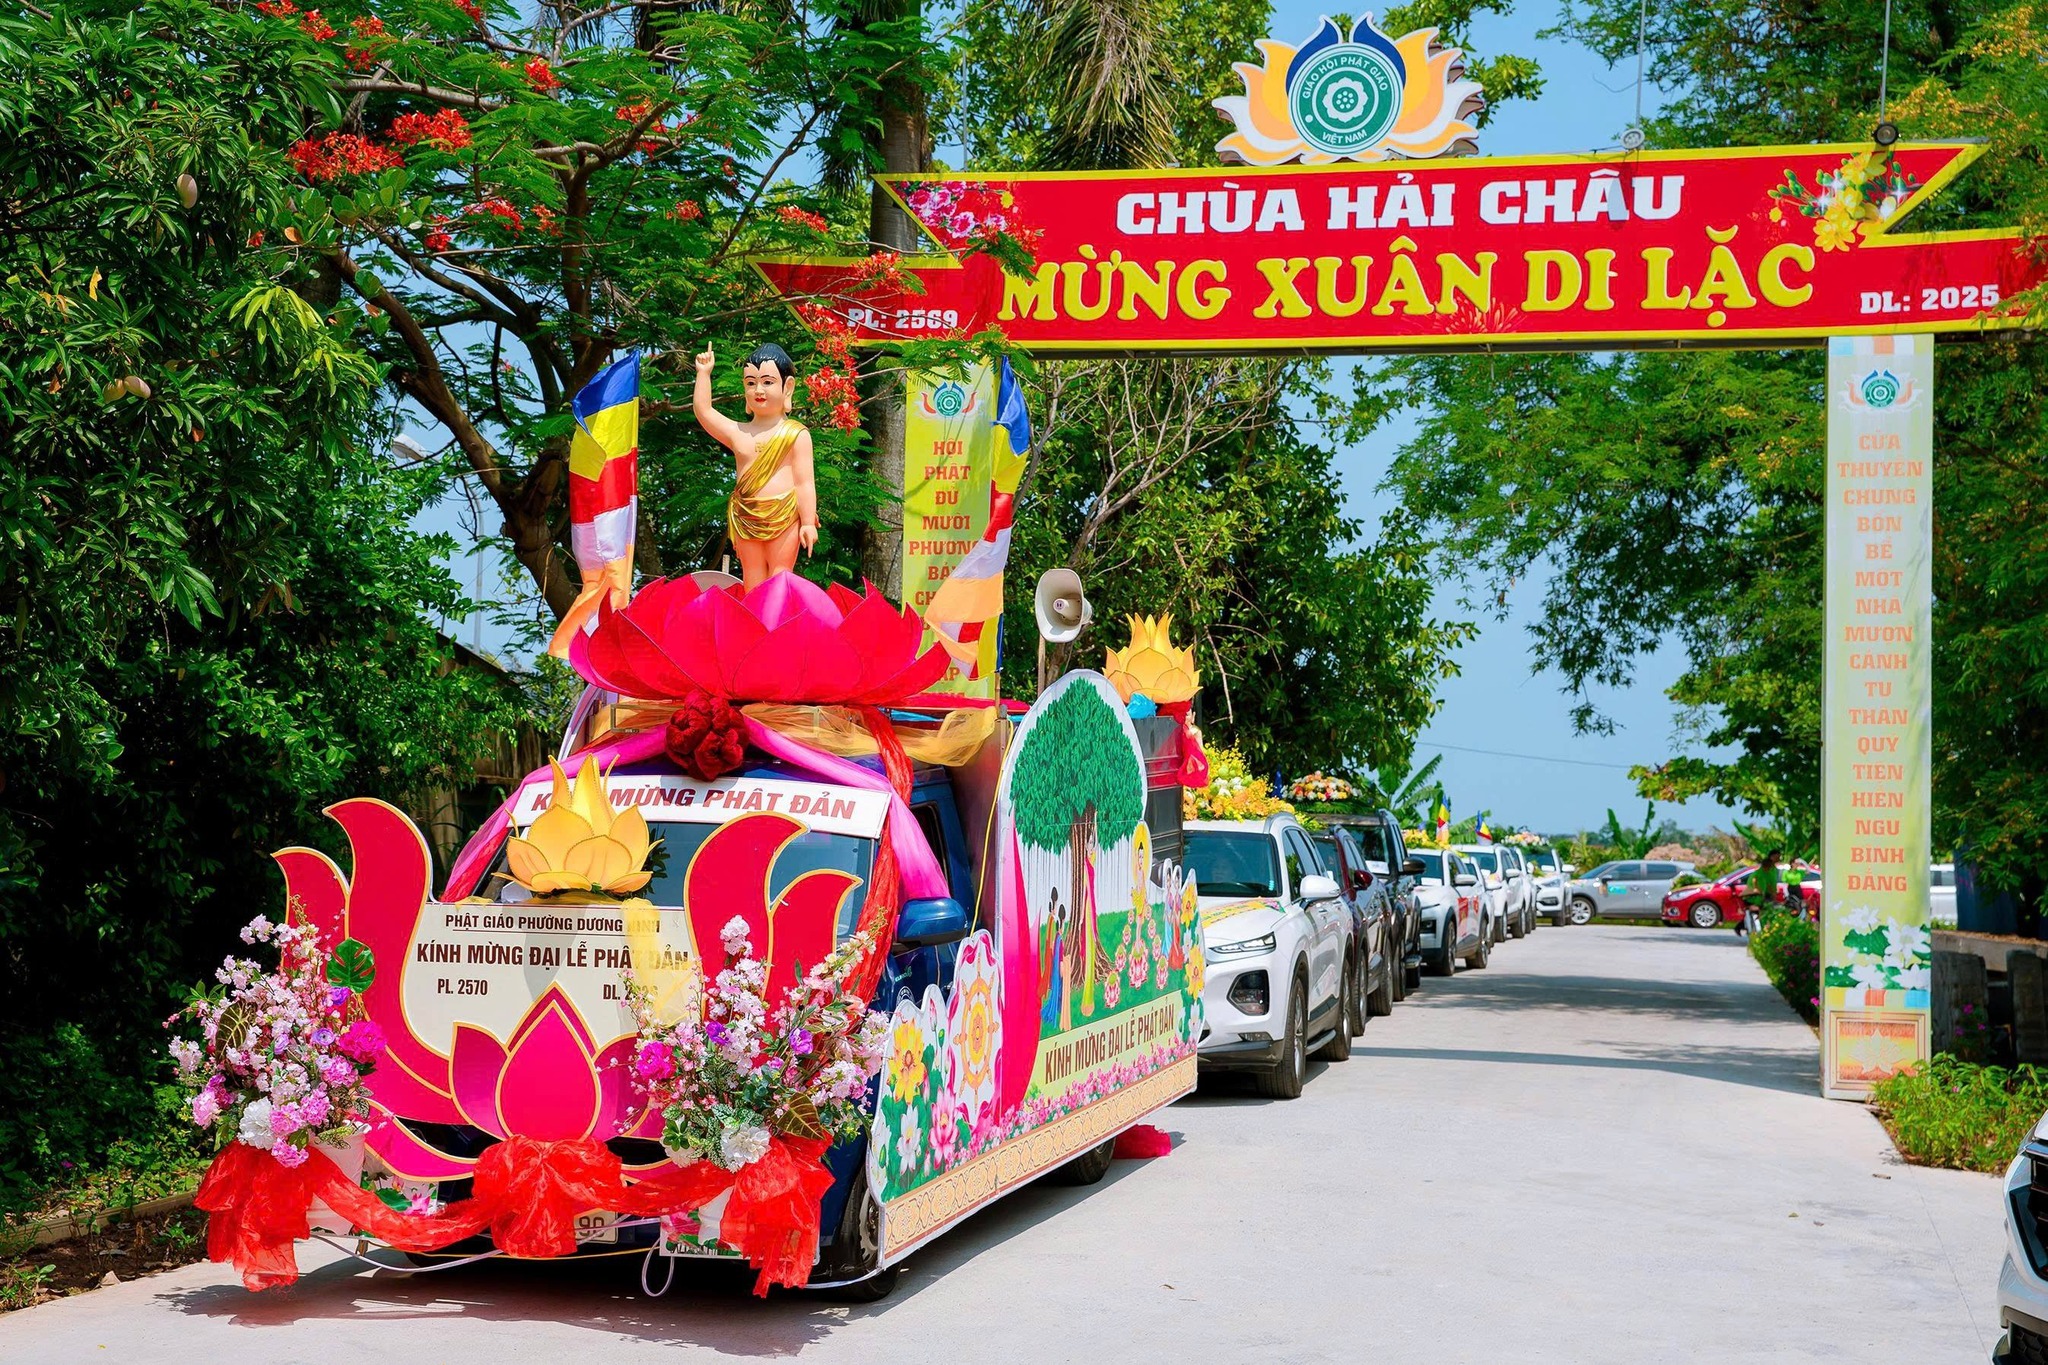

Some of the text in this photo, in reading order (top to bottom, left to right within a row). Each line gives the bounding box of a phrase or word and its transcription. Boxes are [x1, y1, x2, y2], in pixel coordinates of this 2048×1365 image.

[1303, 56, 1388, 98] GIÁO HỘI PHẬT GIÁO
[1322, 129, 1368, 145] VIỆT NAM
[1116, 167, 1686, 236] CHÙA HẢI CHÂU
[996, 224, 1816, 328] MỪNG XUÂN DI LẶC
[1860, 284, 2000, 314] DL: 2025
[847, 308, 958, 329] PL: 2569
[933, 438, 963, 459] HỘI
[1858, 429, 1901, 450] CỬA
[924, 463, 971, 484] PHẬT
[935, 486, 958, 505] ĐỦ
[1843, 488, 1917, 505] CHUNG
[922, 512, 971, 530] MƯỜI
[1857, 510, 1903, 532] BỐN
[928, 562, 956, 581] BẢ
[1855, 568, 1904, 591] MỘT
[1844, 626, 1914, 645] MƯỢN
[1864, 681, 1893, 697] TU
[1848, 705, 1908, 725] THÂN
[1857, 733, 1899, 755] QUÝ
[609, 784, 697, 807] MỪNG
[788, 790, 856, 819] ĐẢN
[1855, 820, 1901, 835] NGU
[1850, 844, 1904, 863] BÌNH
[445, 914, 479, 932] PHẬT
[483, 913, 513, 929] GIÁO
[518, 914, 573, 931] PHƯỜNG
[577, 916, 623, 932] DƯƠNG
[416, 940, 461, 963] KÍNH
[467, 941, 523, 966] MỪNG
[529, 946, 560, 971] ĐẠI
[566, 940, 588, 967] LỄ
[437, 978, 488, 996] PL. 2570
[603, 983, 621, 1000] DL.
[1045, 1042, 1072, 1084] KÍNH
[1075, 1031, 1105, 1073] MỪNG
[1108, 1026, 1124, 1062] ĐẠI
[1126, 1009, 1135, 1052] LỄ
[1159, 996, 1174, 1035] ĐẢN
